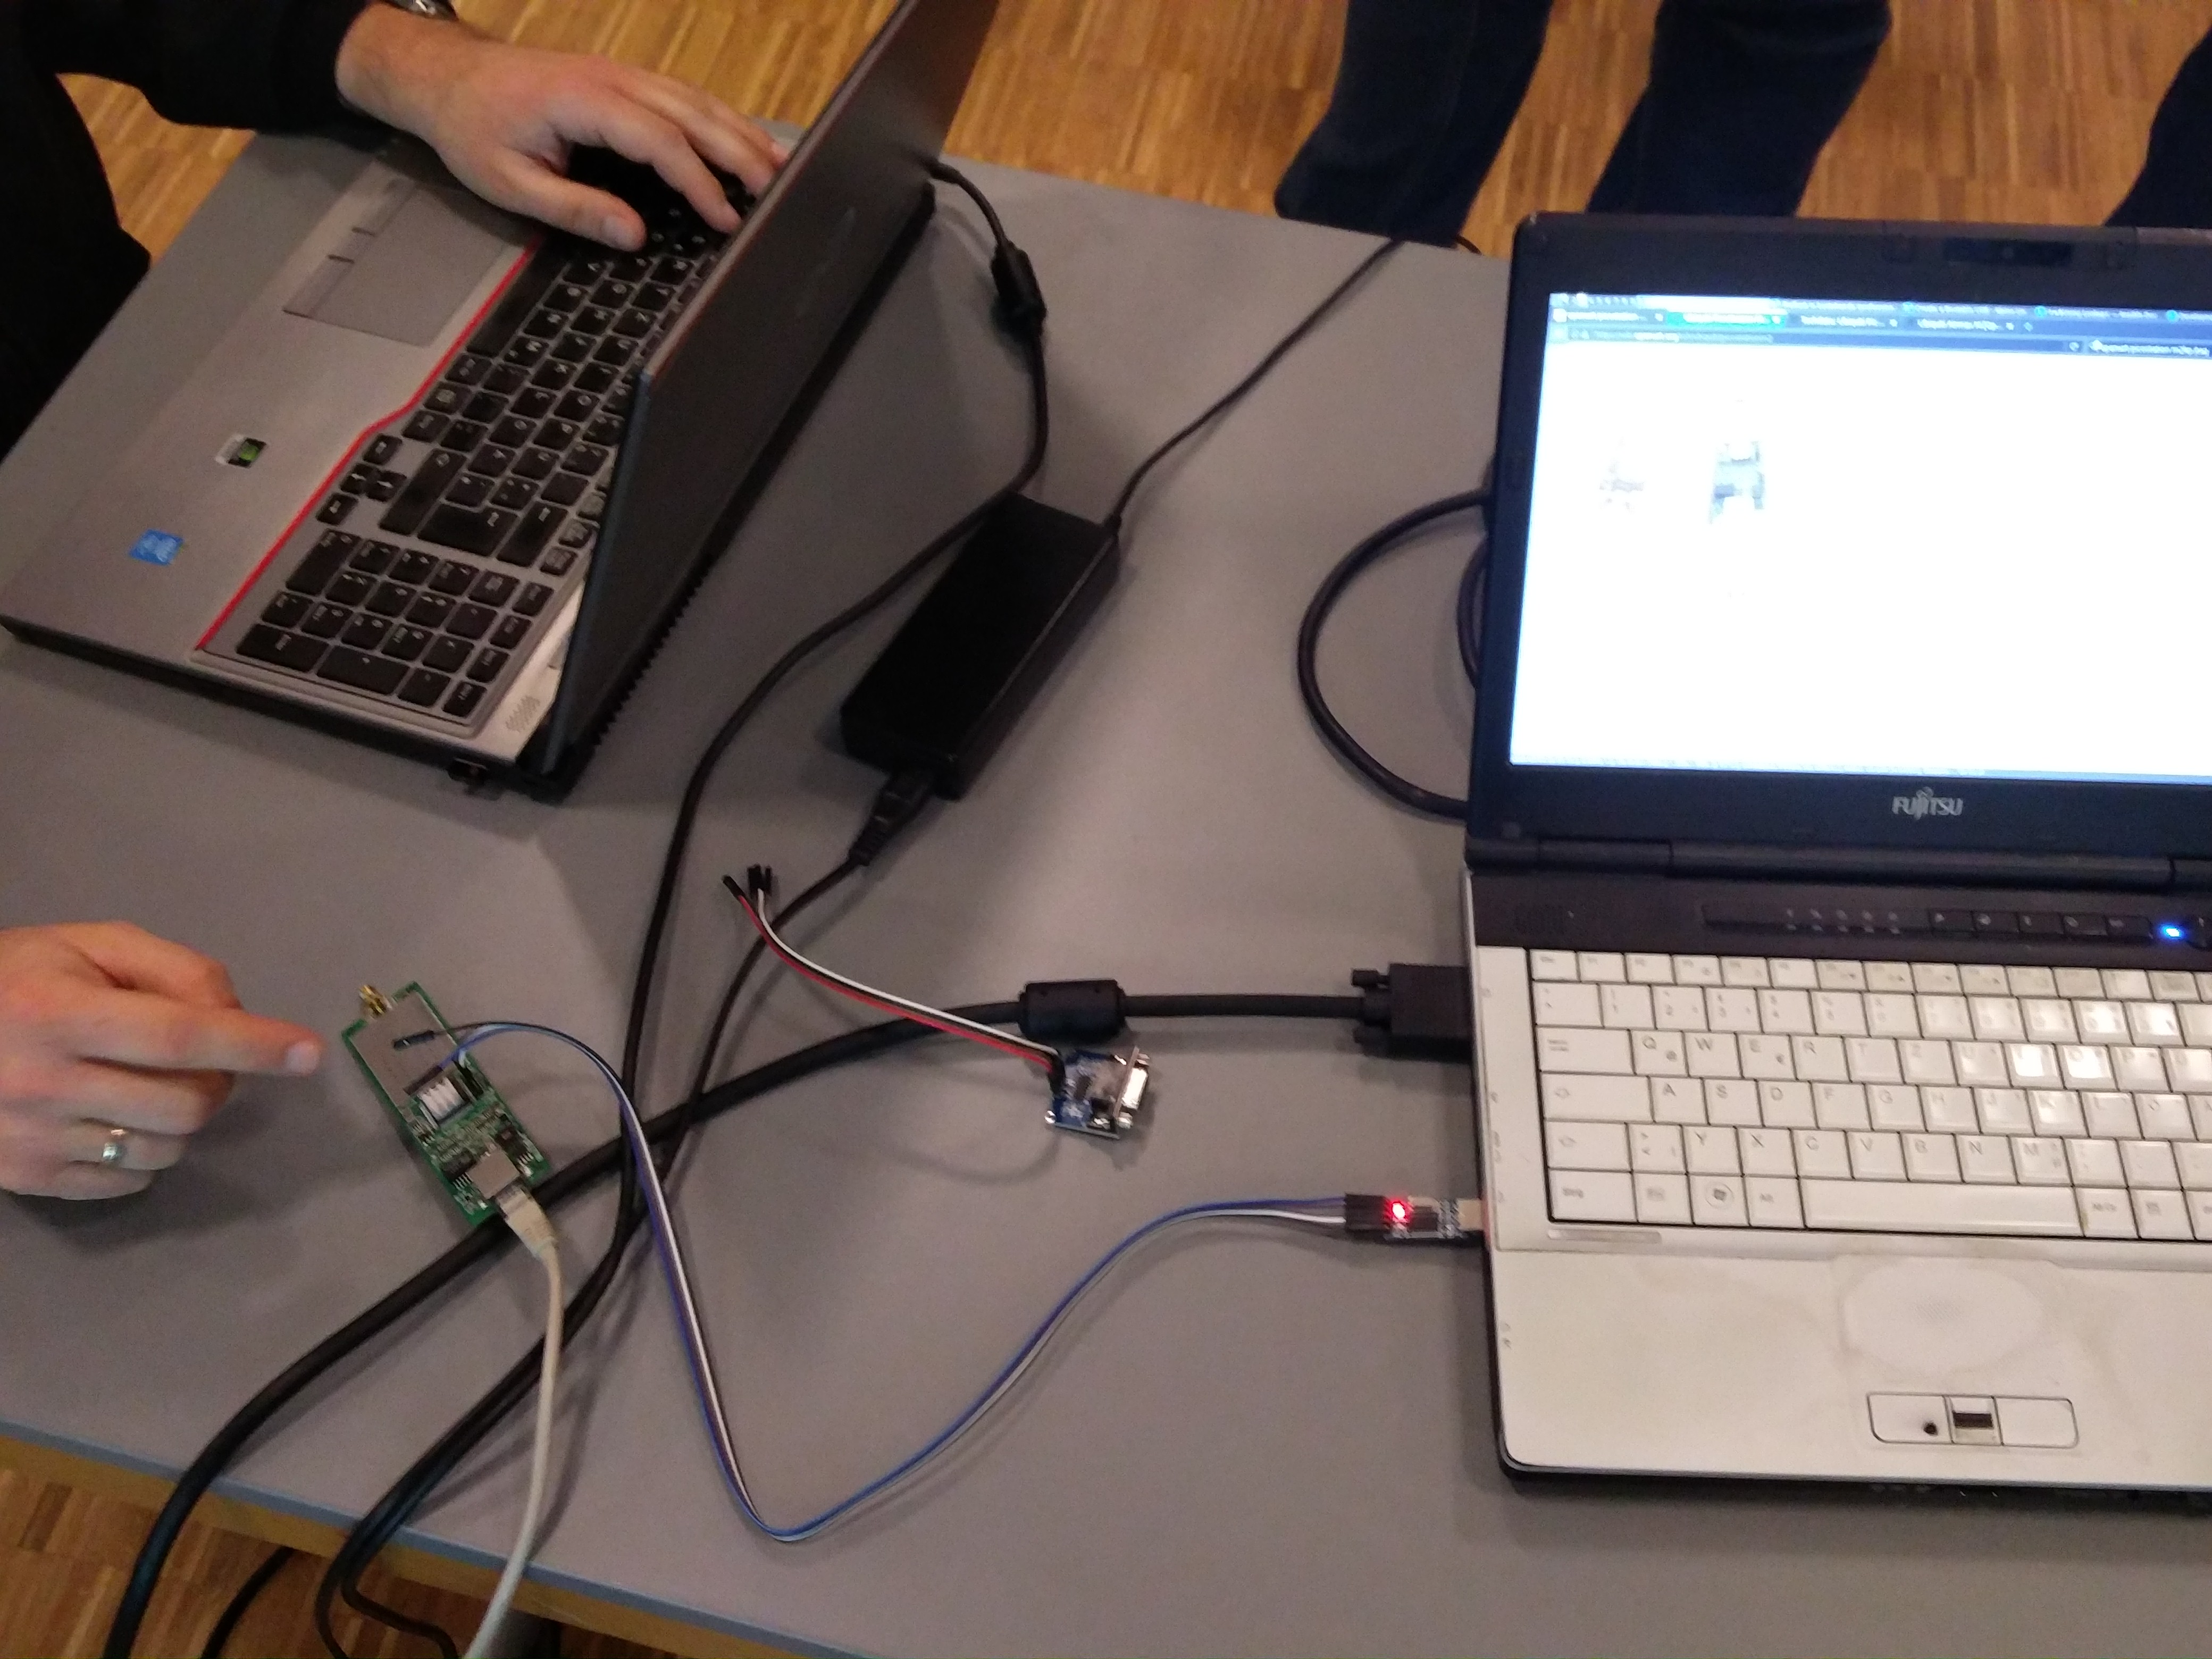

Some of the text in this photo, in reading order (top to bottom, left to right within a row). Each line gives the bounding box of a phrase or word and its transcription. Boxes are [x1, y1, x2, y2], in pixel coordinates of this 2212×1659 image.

[1891, 787, 1964, 820] FUJITSU
[1642, 1036, 1656, 1050] Q
[1663, 1083, 1676, 1096] A
